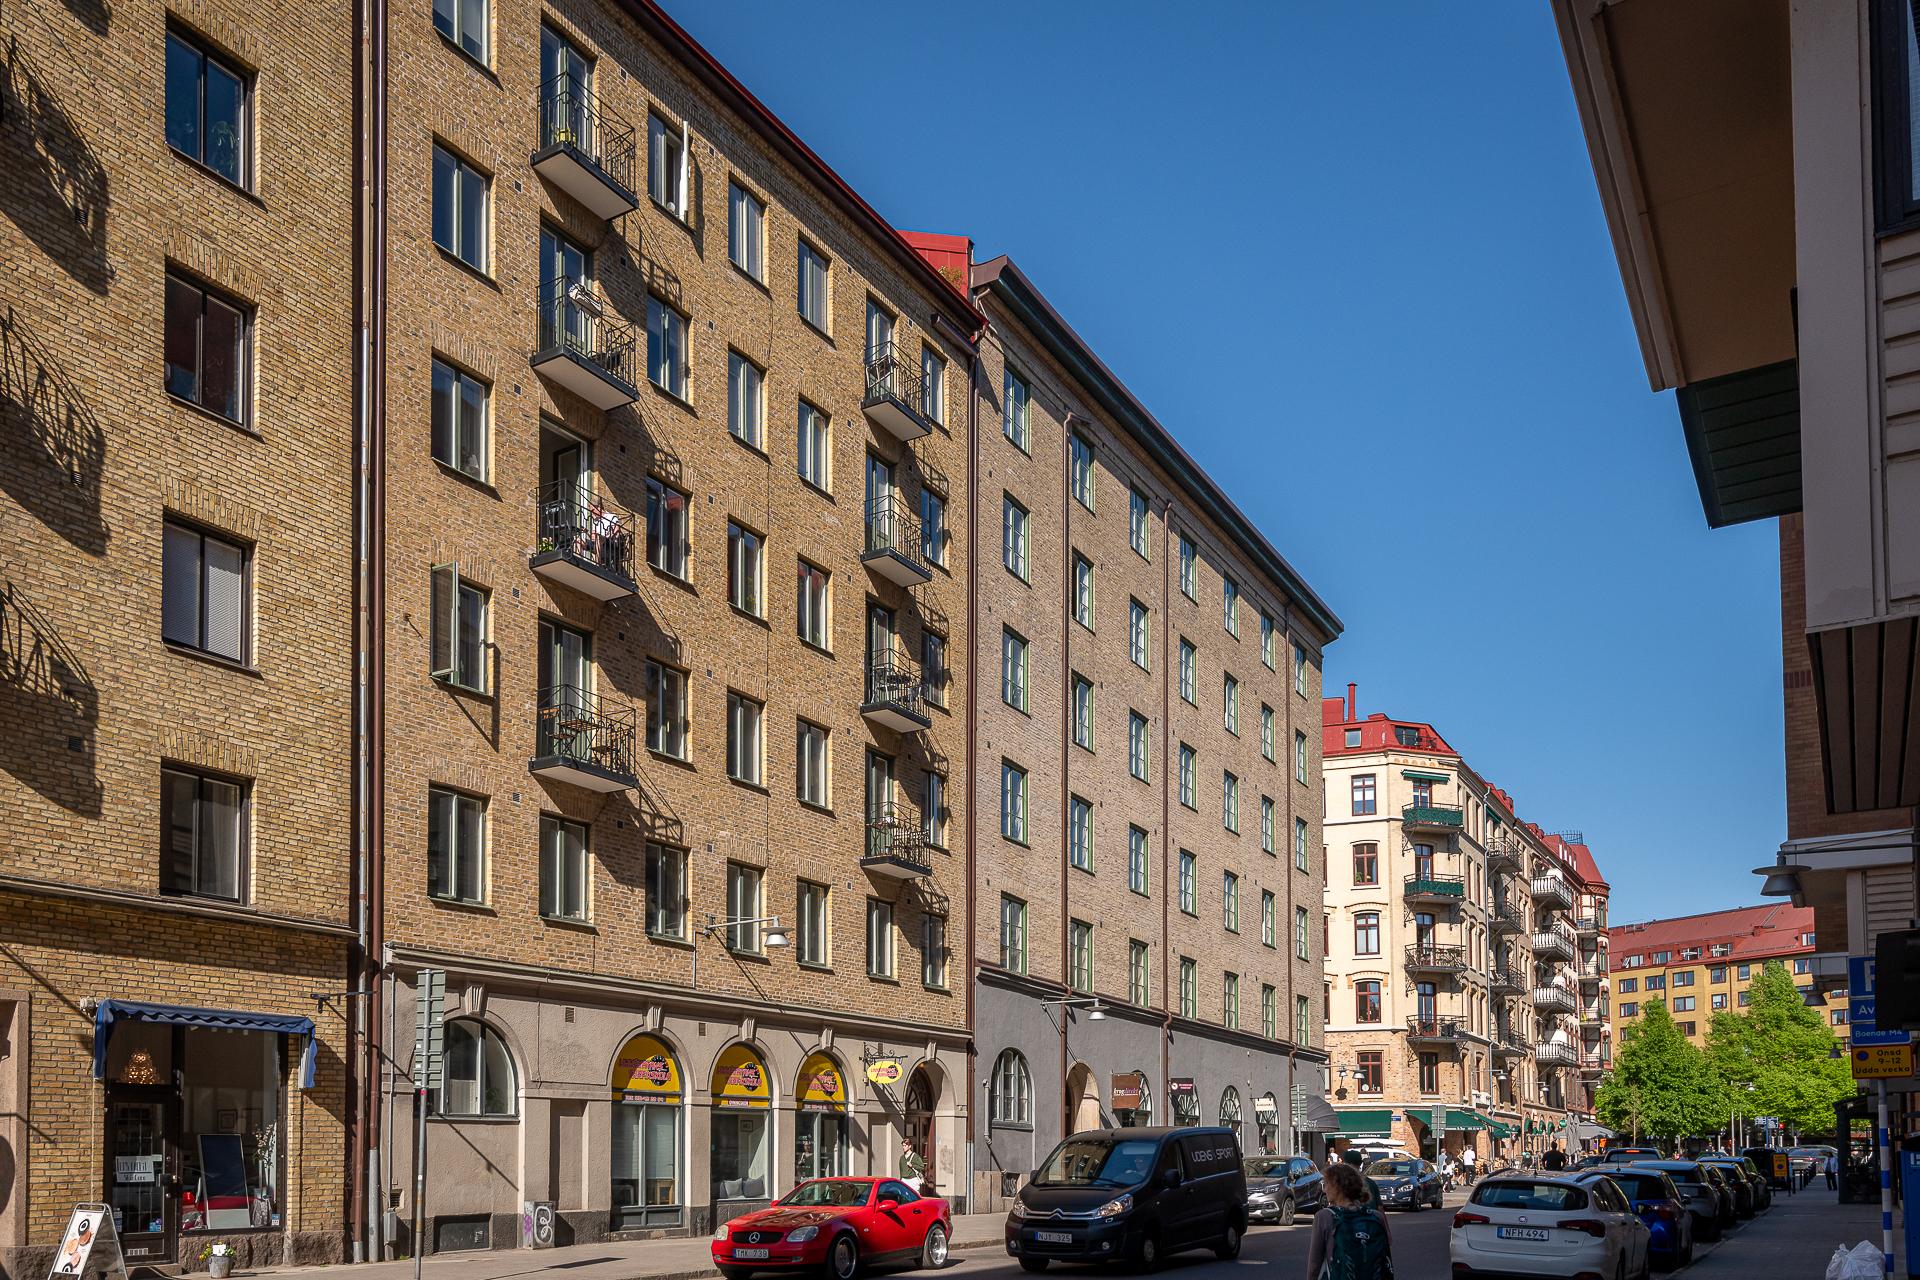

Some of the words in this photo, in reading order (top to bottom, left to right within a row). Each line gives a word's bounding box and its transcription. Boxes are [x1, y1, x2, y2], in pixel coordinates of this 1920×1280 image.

[1876, 1049, 1902, 1057] Onsd
[1855, 1066, 1880, 1075] Udda
[1882, 1065, 1911, 1073] vecka
[1215, 1147, 1234, 1160] SPORT
[1505, 1228, 1524, 1237] NFH
[1525, 1229, 1545, 1239] 494
